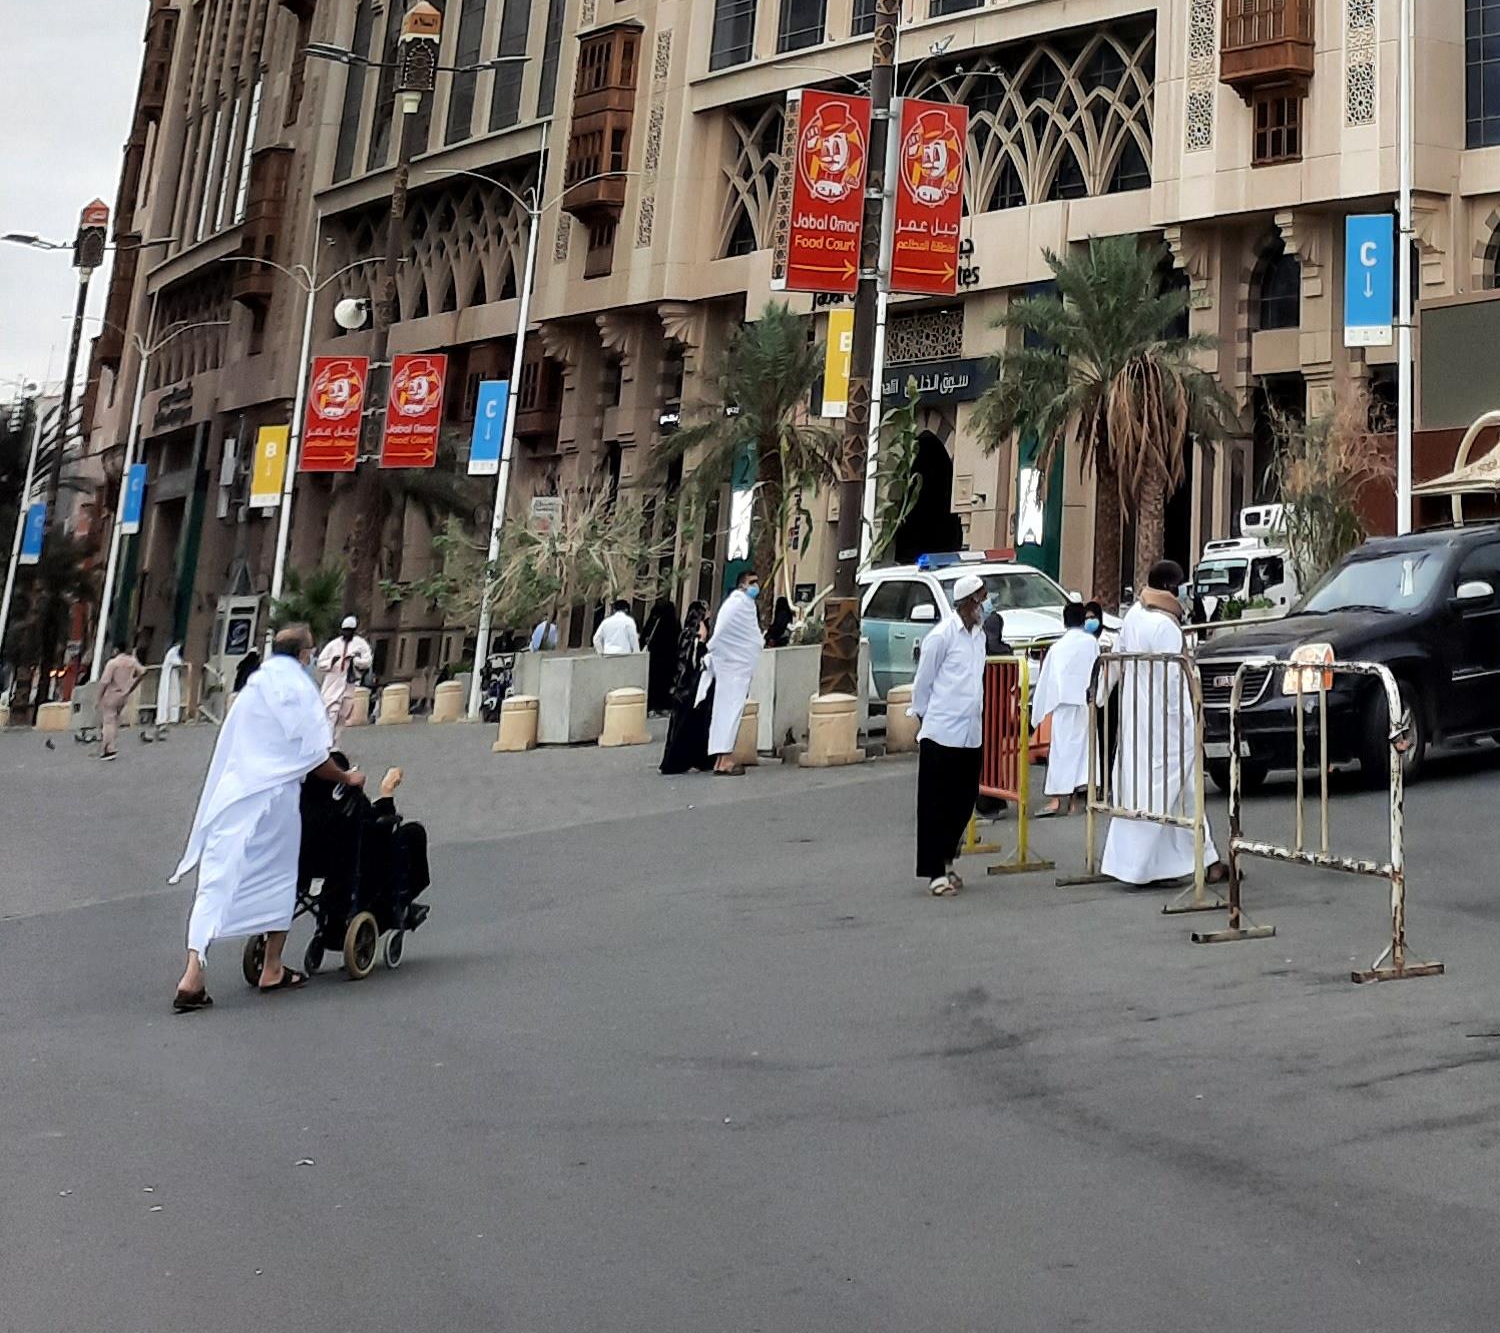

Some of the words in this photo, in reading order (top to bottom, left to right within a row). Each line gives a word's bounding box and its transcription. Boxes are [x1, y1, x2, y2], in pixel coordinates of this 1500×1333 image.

[793, 212, 828, 231] Jabal
[829, 215, 860, 233] Omar
[896, 219, 928, 234] عمر
[930, 217, 959, 237] جبل
[795, 234, 825, 249] Food
[825, 237, 856, 252] Court
[1360, 241, 1377, 267] C
[940, 373, 969, 394] سوق
[486, 400, 497, 418] C
